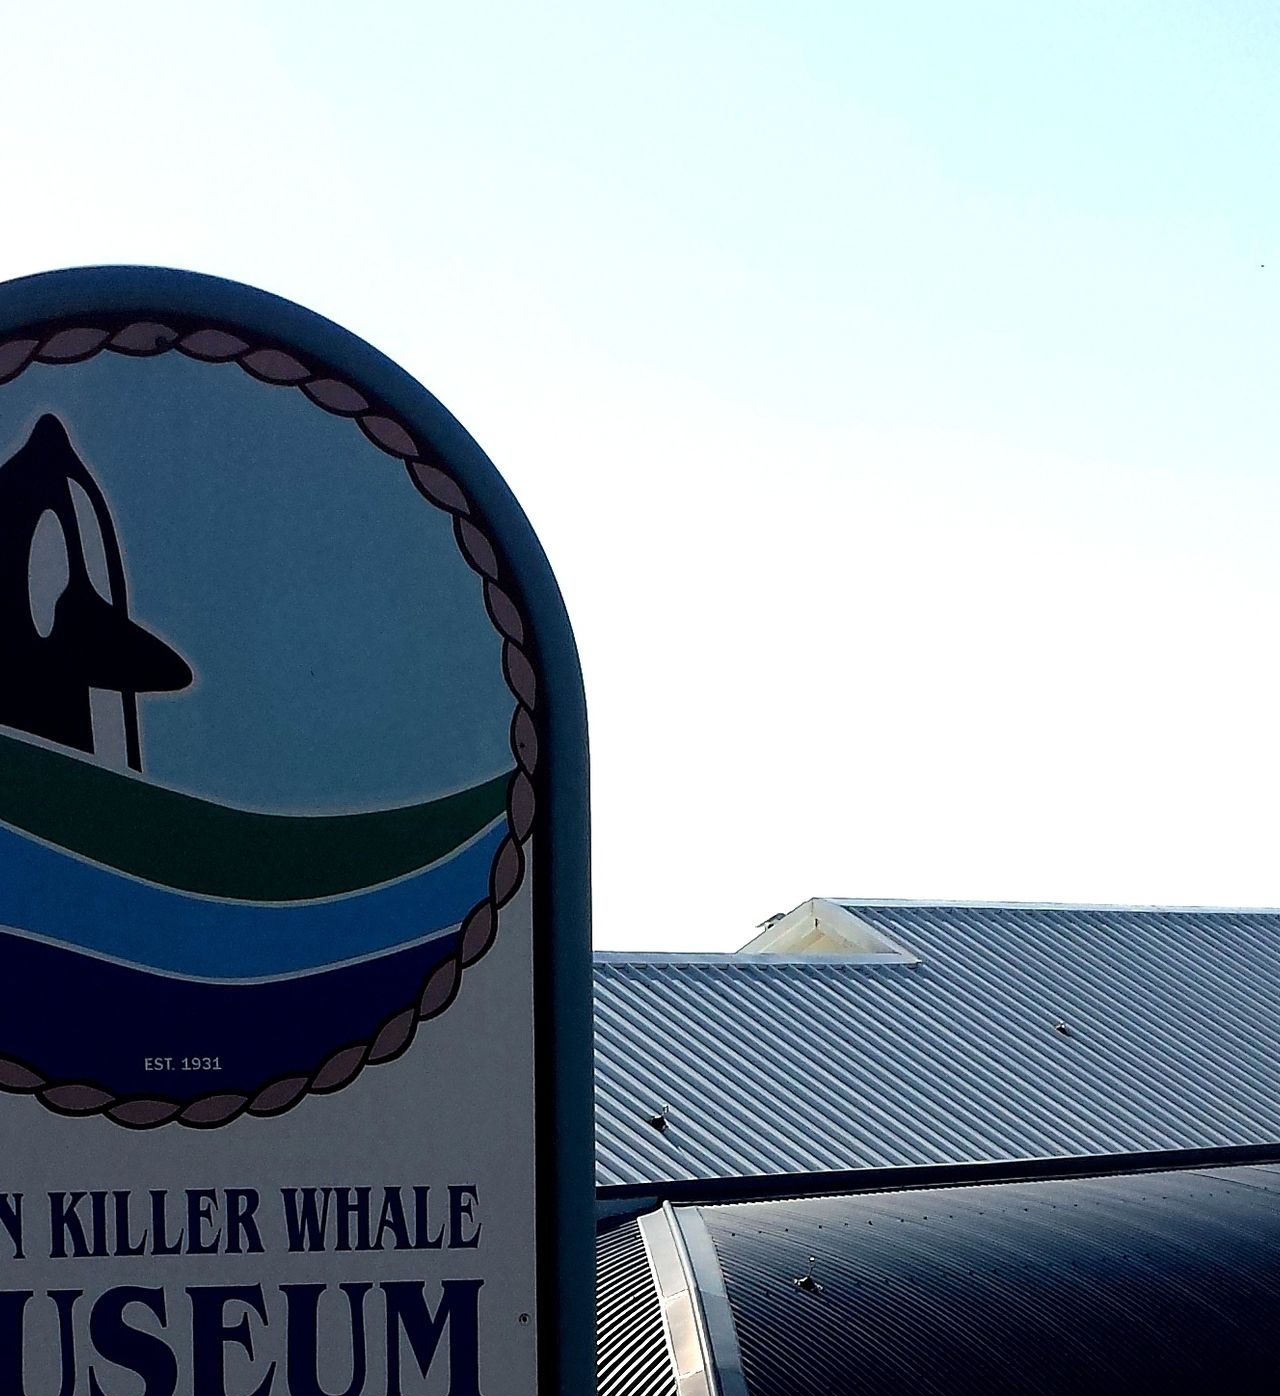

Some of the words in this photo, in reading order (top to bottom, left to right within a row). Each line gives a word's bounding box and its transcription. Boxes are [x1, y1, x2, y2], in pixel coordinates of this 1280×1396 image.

[144, 1057, 176, 1071] EST.
[181, 1057, 222, 1070] 1931
[47, 1188, 265, 1258] KILLER
[280, 1184, 482, 1252] WHALE
